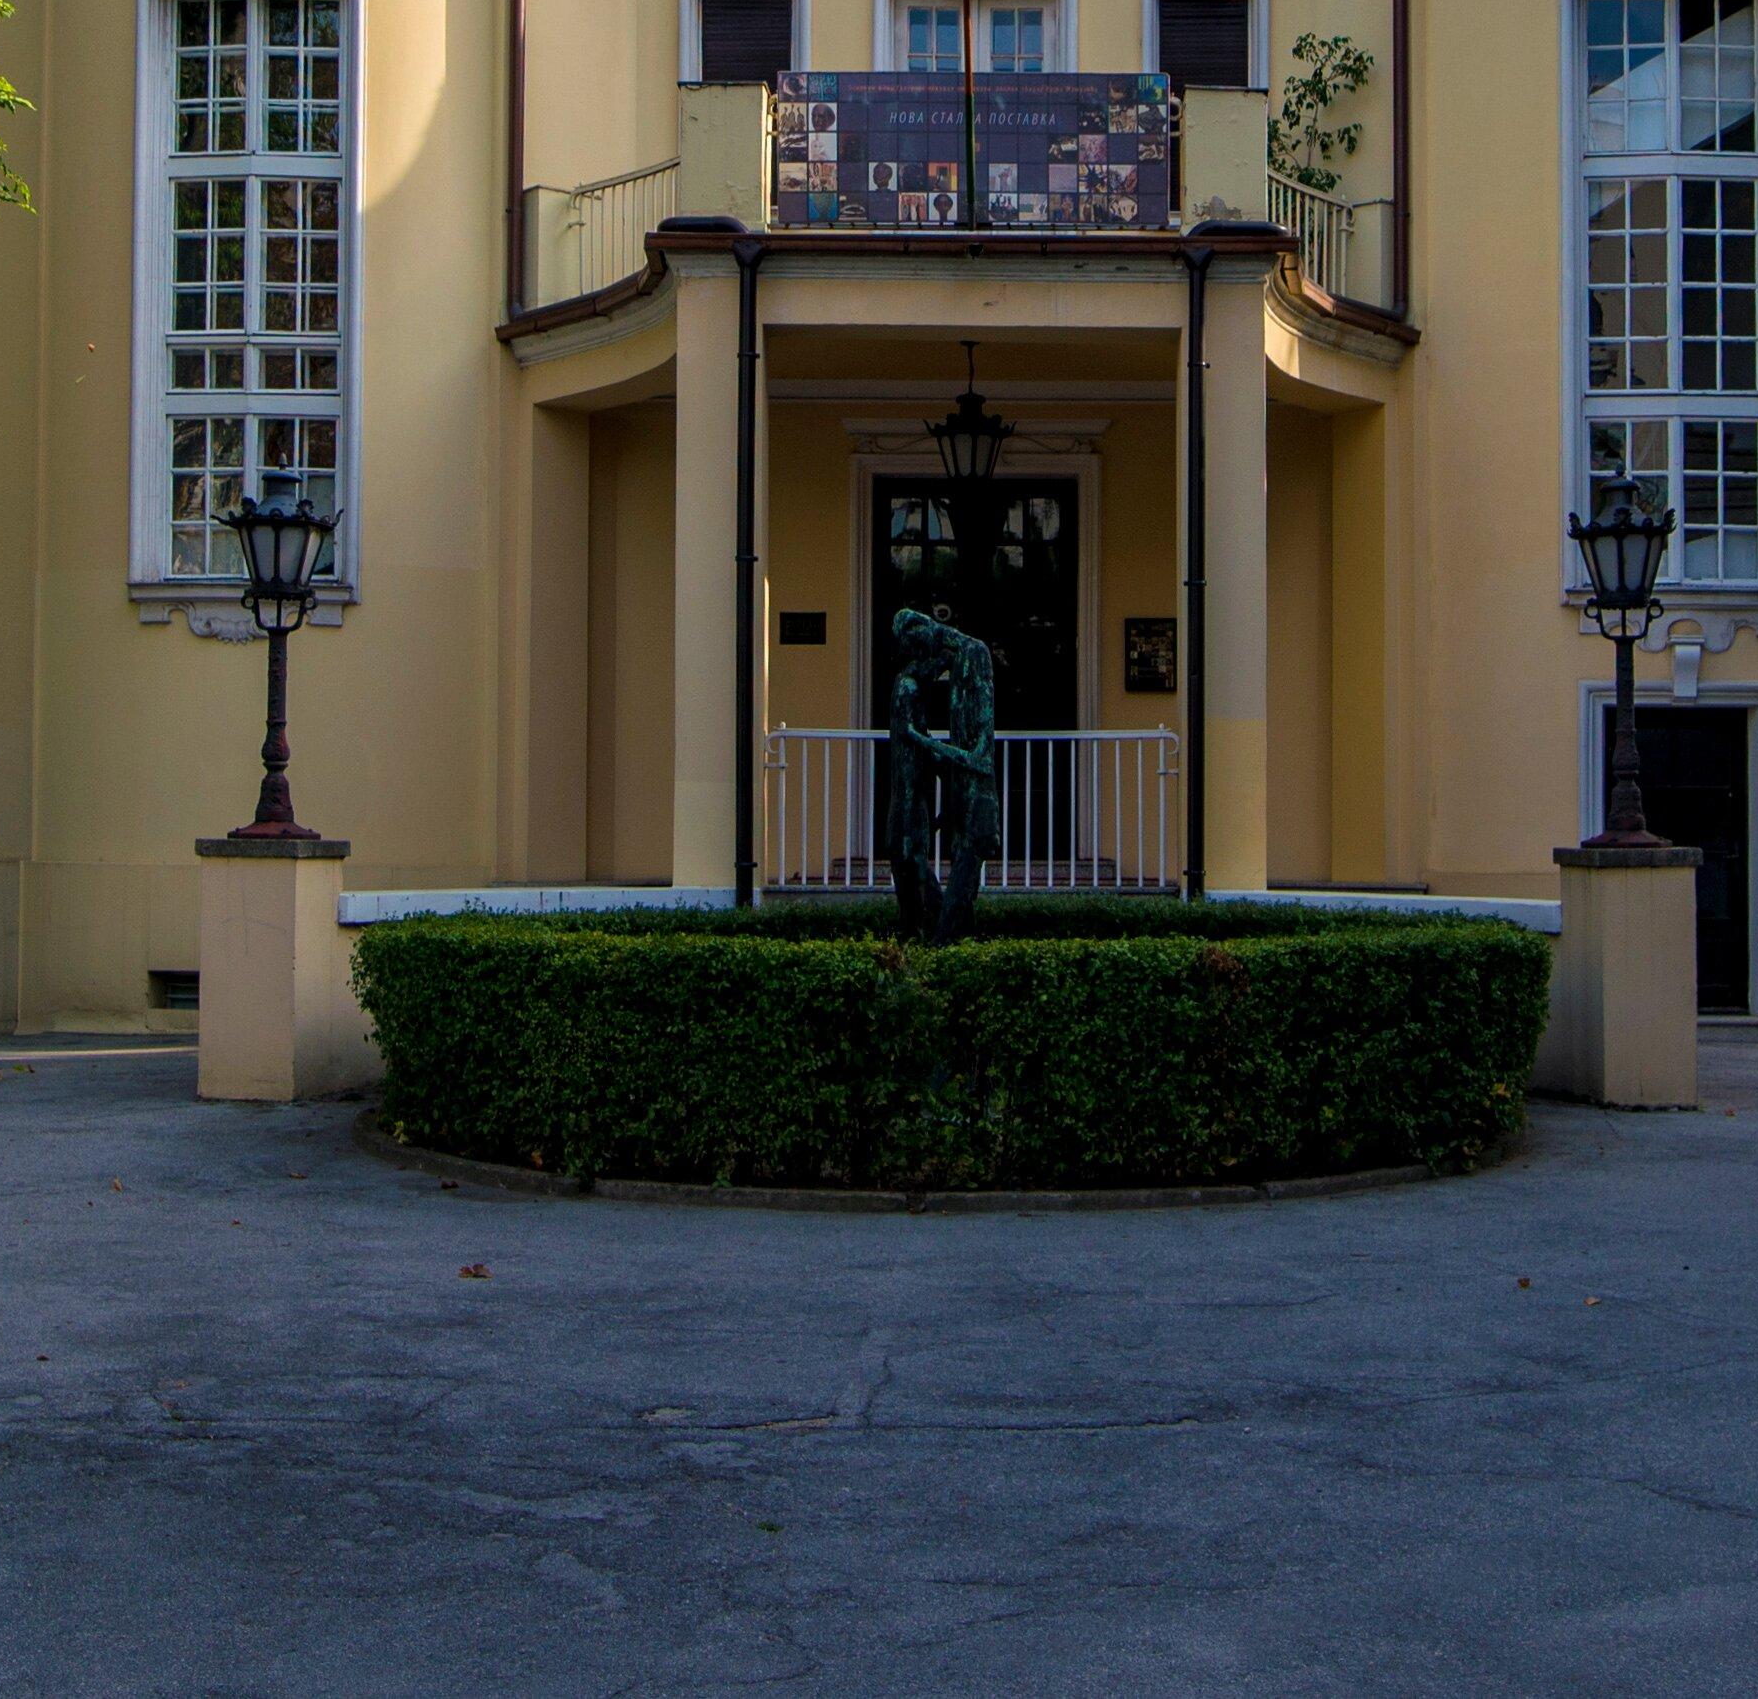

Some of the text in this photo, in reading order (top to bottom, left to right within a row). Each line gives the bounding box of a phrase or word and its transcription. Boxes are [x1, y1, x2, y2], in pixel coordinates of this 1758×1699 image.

[889, 111, 1056, 125] НОВА СТАЛА ПОСТАВКА
